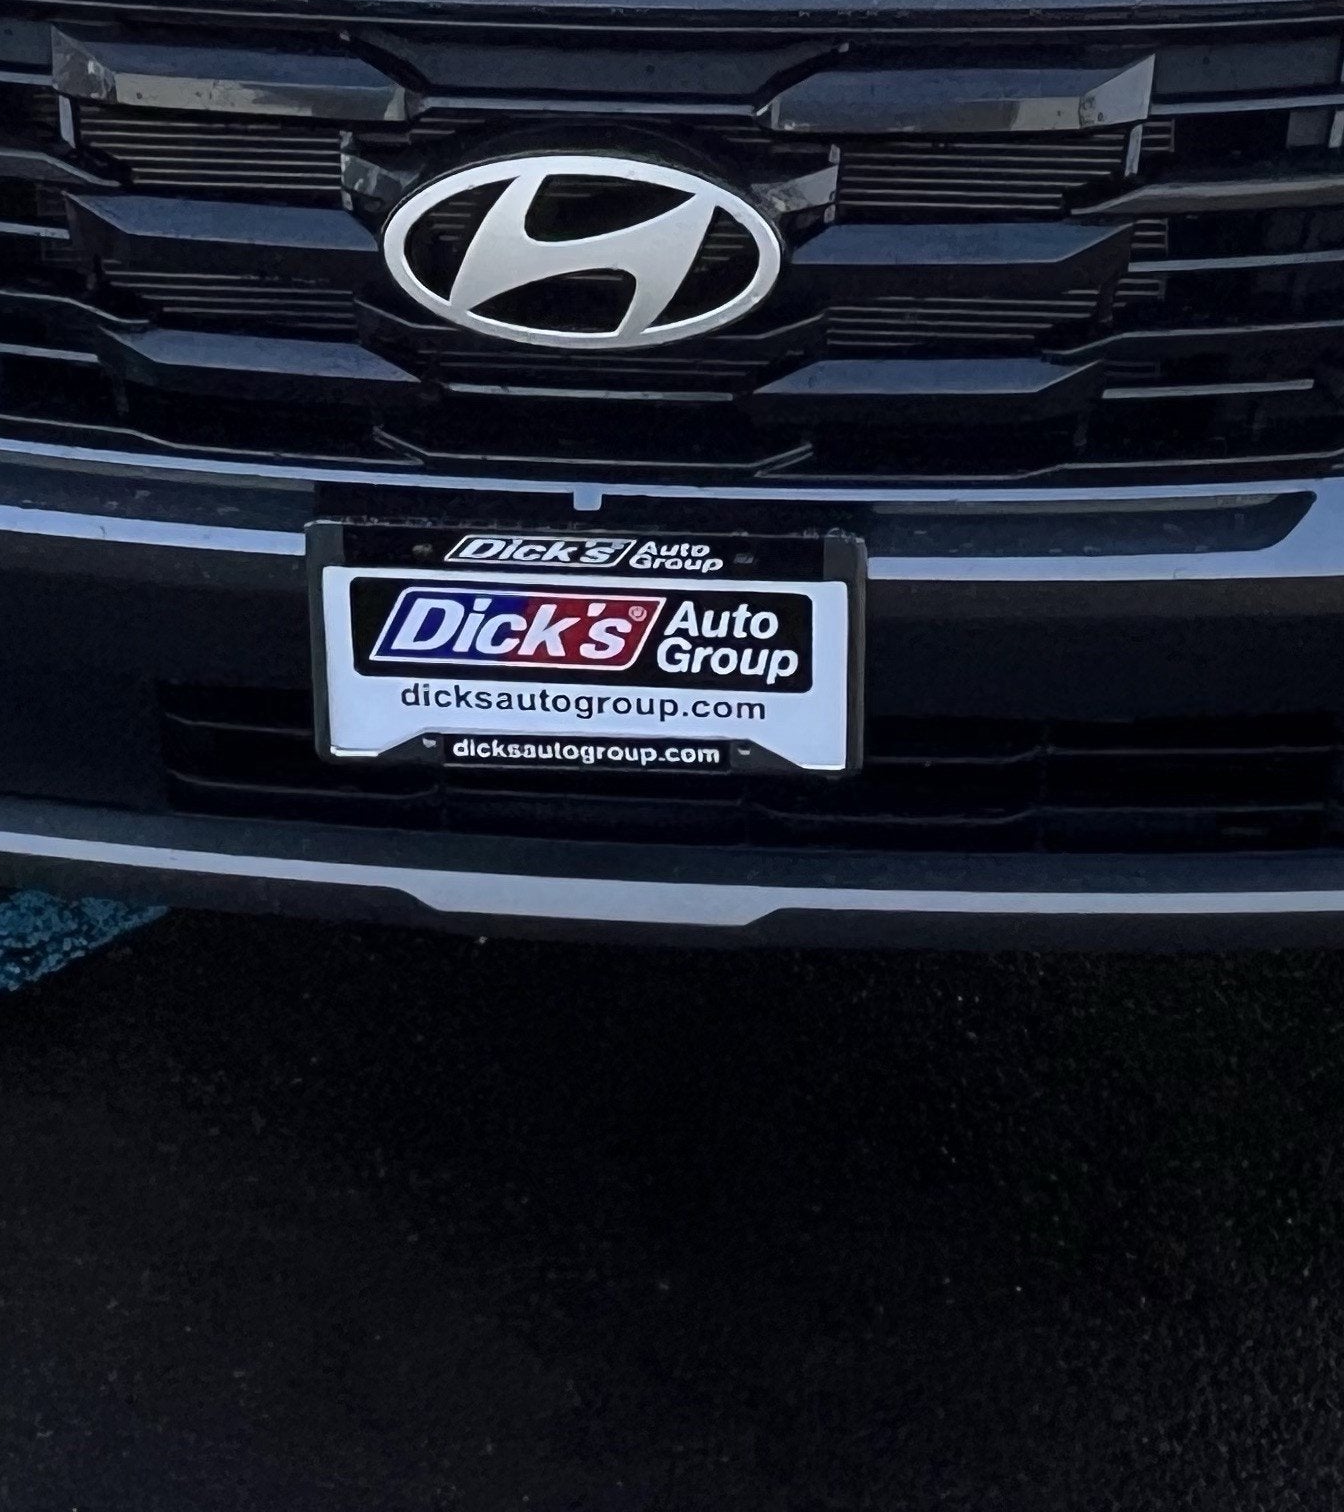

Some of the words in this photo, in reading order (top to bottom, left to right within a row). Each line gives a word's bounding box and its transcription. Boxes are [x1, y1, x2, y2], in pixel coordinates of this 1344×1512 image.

[457, 537, 626, 564] Dick's
[635, 540, 711, 557] Auto
[628, 553, 724, 574] Group
[663, 600, 779, 640] Auto
[655, 636, 799, 685] Group
[400, 683, 766, 720] dicksautogroup.com
[452, 738, 720, 767] dicksautogroup.com
